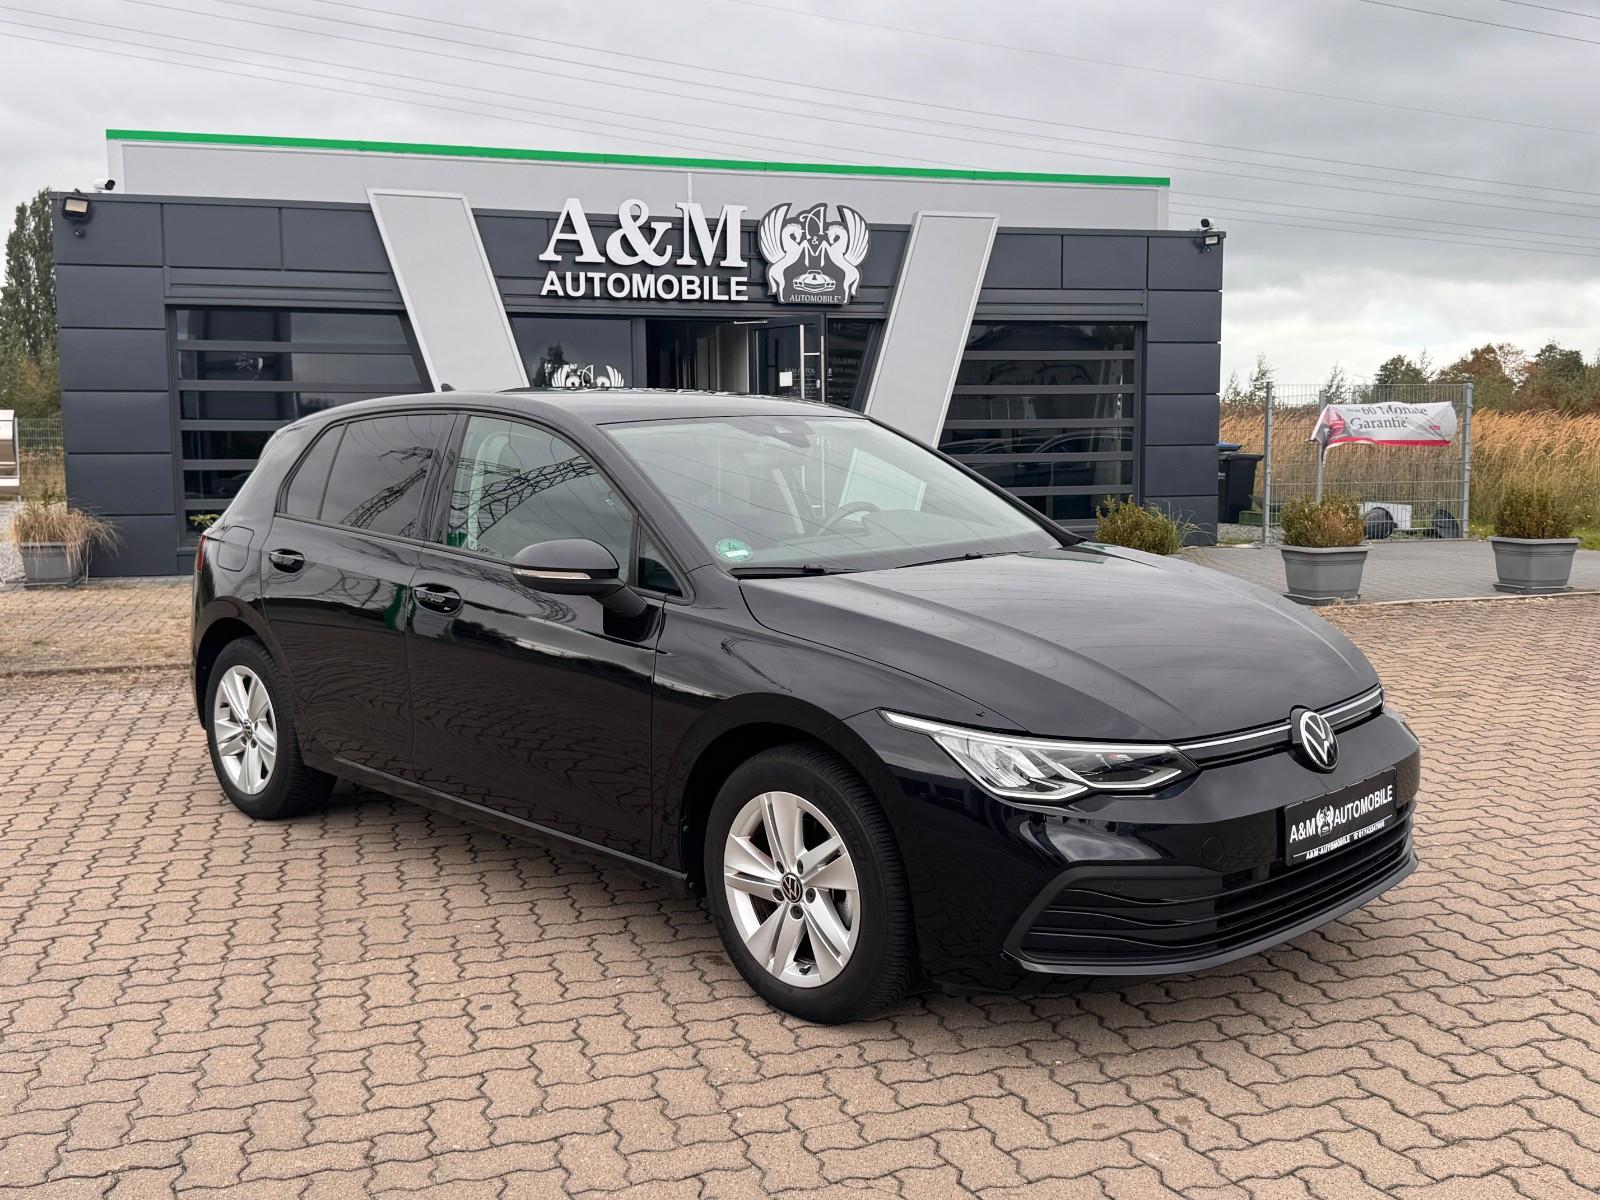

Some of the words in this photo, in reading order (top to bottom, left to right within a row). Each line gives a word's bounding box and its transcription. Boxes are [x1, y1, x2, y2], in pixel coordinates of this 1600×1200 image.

[539, 197, 748, 267] A&M
[540, 271, 749, 301] AUTOMOBILE
[1290, 817, 1315, 843] A&M
[1334, 784, 1393, 826] AUTOMOBILE
